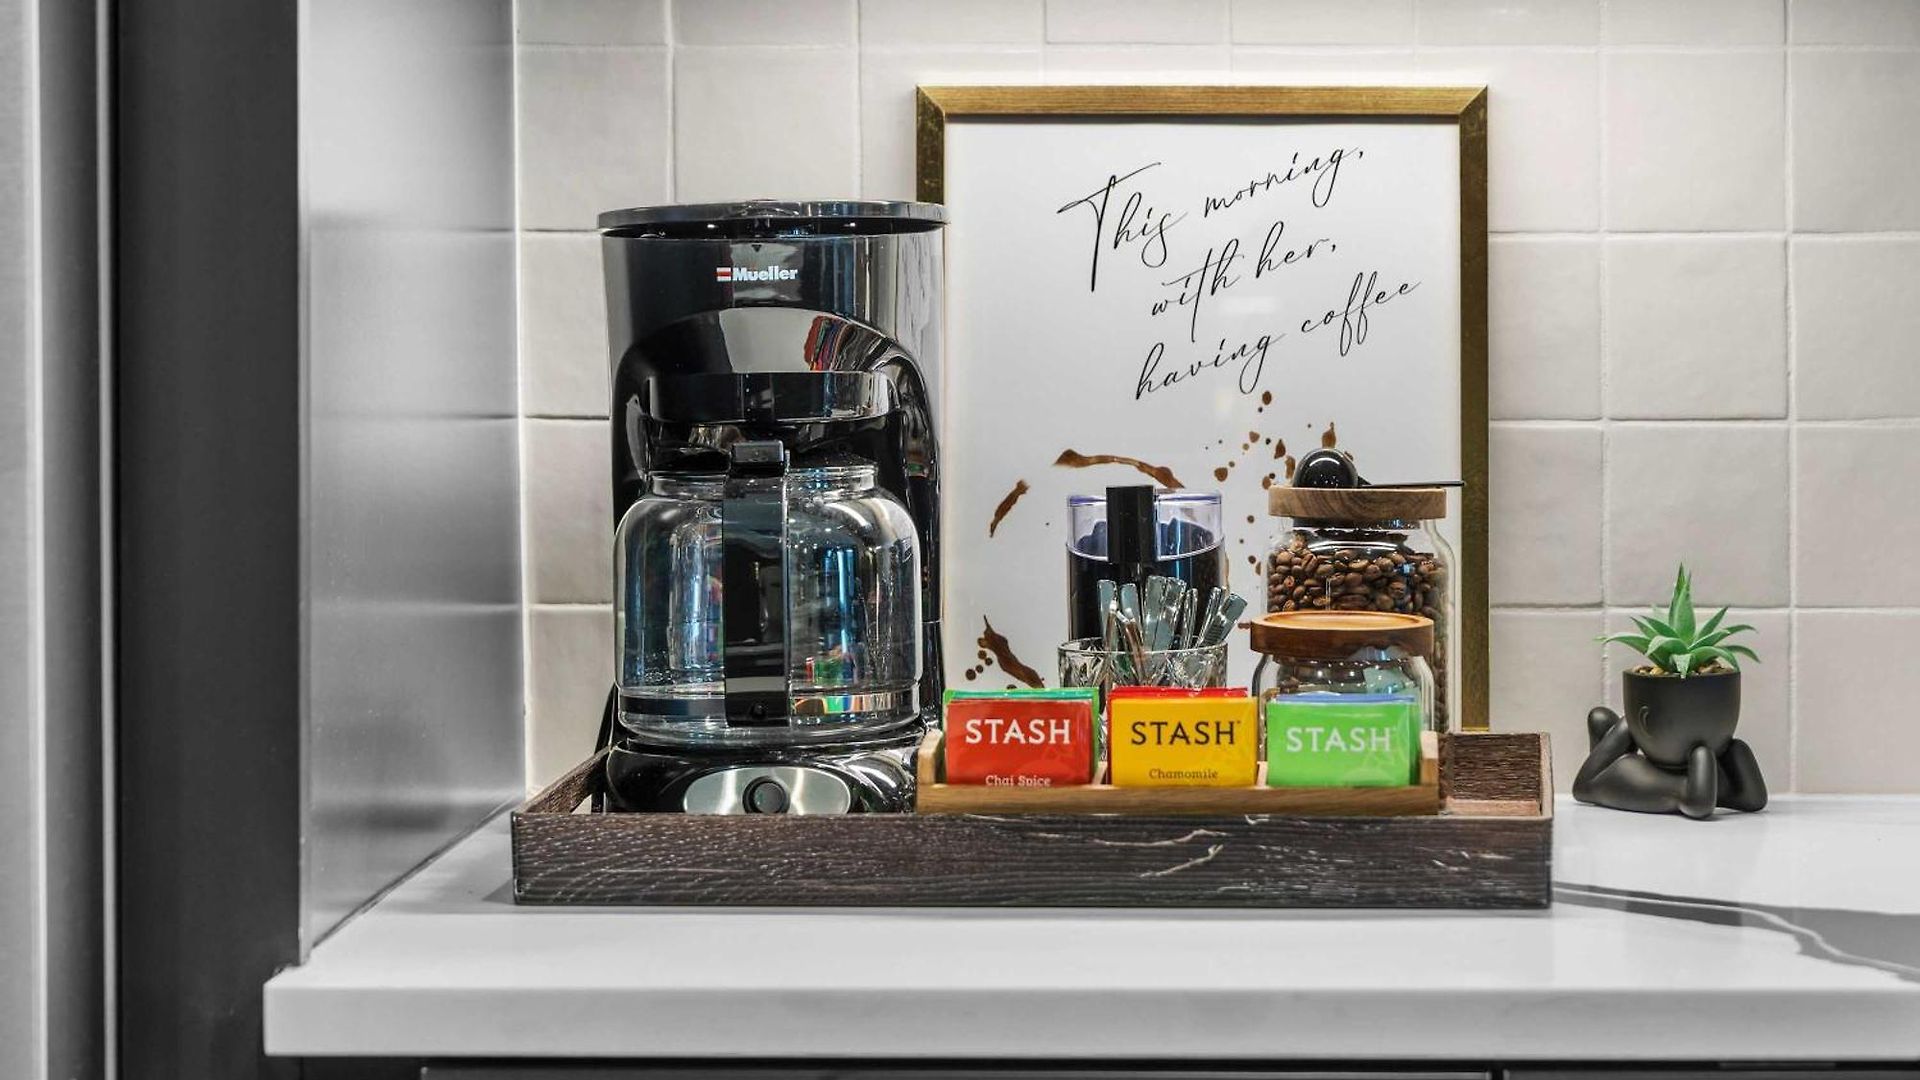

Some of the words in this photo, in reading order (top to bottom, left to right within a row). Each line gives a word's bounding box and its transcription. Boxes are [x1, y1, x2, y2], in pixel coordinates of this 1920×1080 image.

[1057, 161, 1187, 292] This
[1204, 146, 1364, 218] morning,
[732, 265, 798, 281] Mueller
[1151, 238, 1245, 342] with
[1255, 220, 1337, 279] her,
[1135, 333, 1286, 400] having
[1300, 271, 1421, 357] coffee
[965, 718, 1070, 744] STASH
[1131, 720, 1235, 745] STASH
[1286, 726, 1392, 752] STASH
[985, 774, 1014, 787] Chai
[1018, 774, 1052, 787] Spice
[1149, 768, 1218, 780] Chamomile
